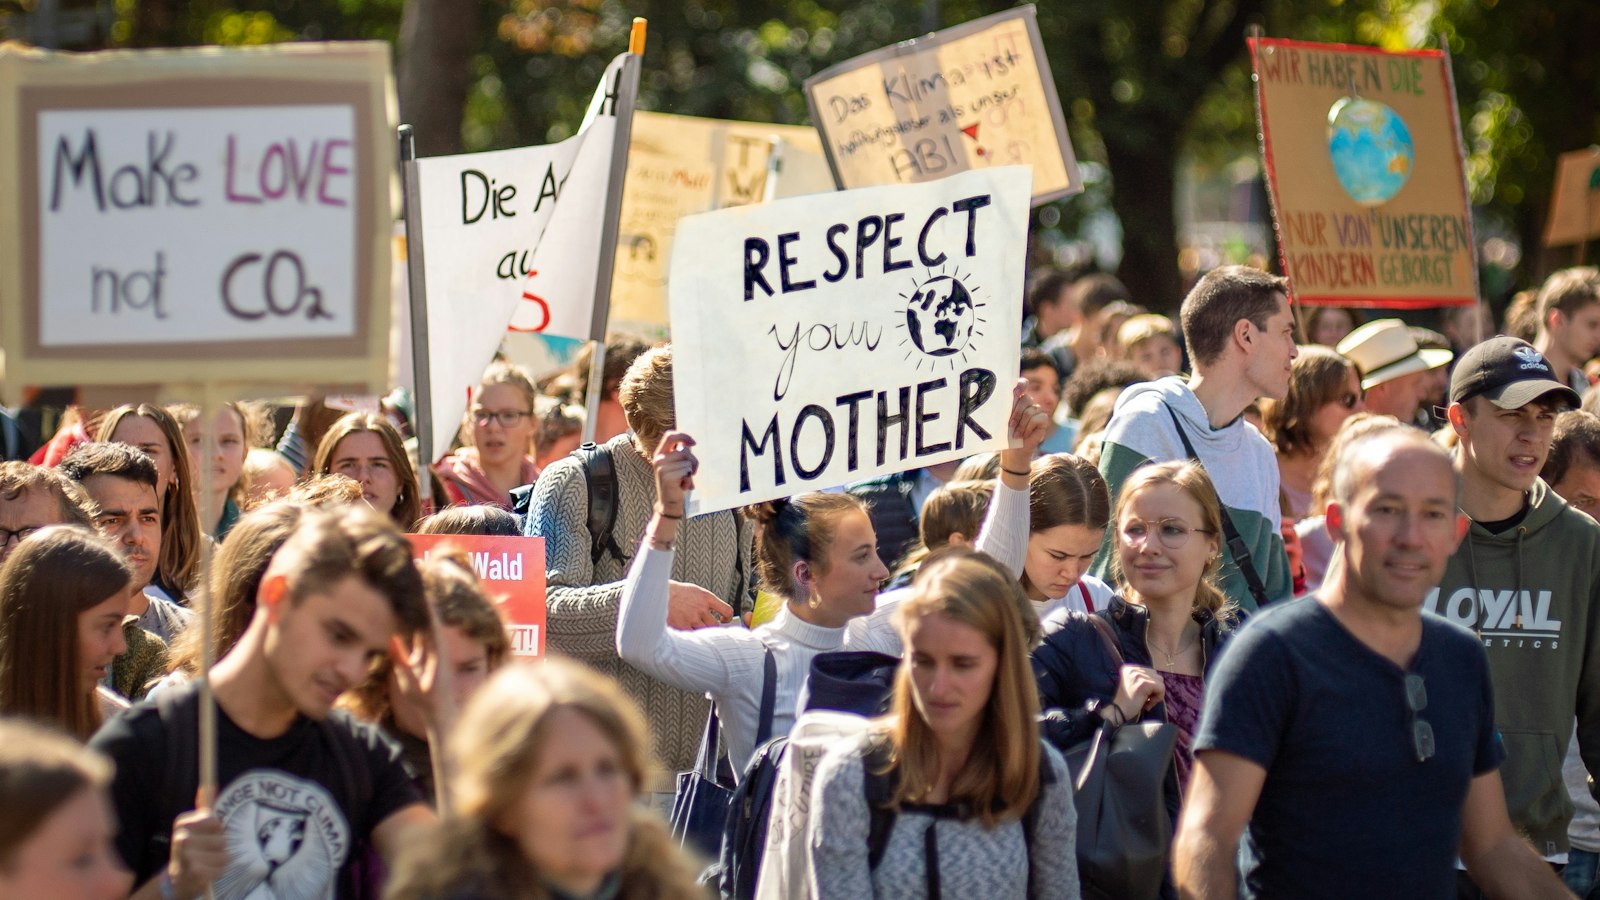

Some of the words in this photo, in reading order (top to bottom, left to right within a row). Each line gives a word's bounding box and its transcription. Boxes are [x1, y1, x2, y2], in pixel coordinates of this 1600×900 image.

[829, 93, 872, 124] Das
[882, 66, 967, 110] Klima
[984, 50, 1021, 80] ist
[1260, 48, 1303, 83] WIR
[1308, 53, 1382, 92] HABEN
[1387, 58, 1425, 95] DIE
[939, 105, 964, 126] als
[48, 126, 201, 213] Make
[225, 133, 353, 208] LOVE
[889, 133, 958, 182] ABI
[461, 169, 516, 225] Die
[744, 194, 991, 301] RESPECT
[1285, 212, 1328, 247] NUR
[1331, 213, 1373, 248] VON
[1378, 214, 1468, 251] UNSEREN
[91, 250, 168, 319] not
[1291, 252, 1376, 288] KINDERN
[768, 321, 883, 401] your
[1520, 362, 1548, 371] adidas
[740, 368, 997, 494] MOTHER
[468, 552, 523, 580] Wald
[1422, 587, 1561, 631] LOYAL
[1485, 639, 1558, 649] ETICS
[216, 783, 254, 821] ANGE
[259, 781, 300, 801] NOT
